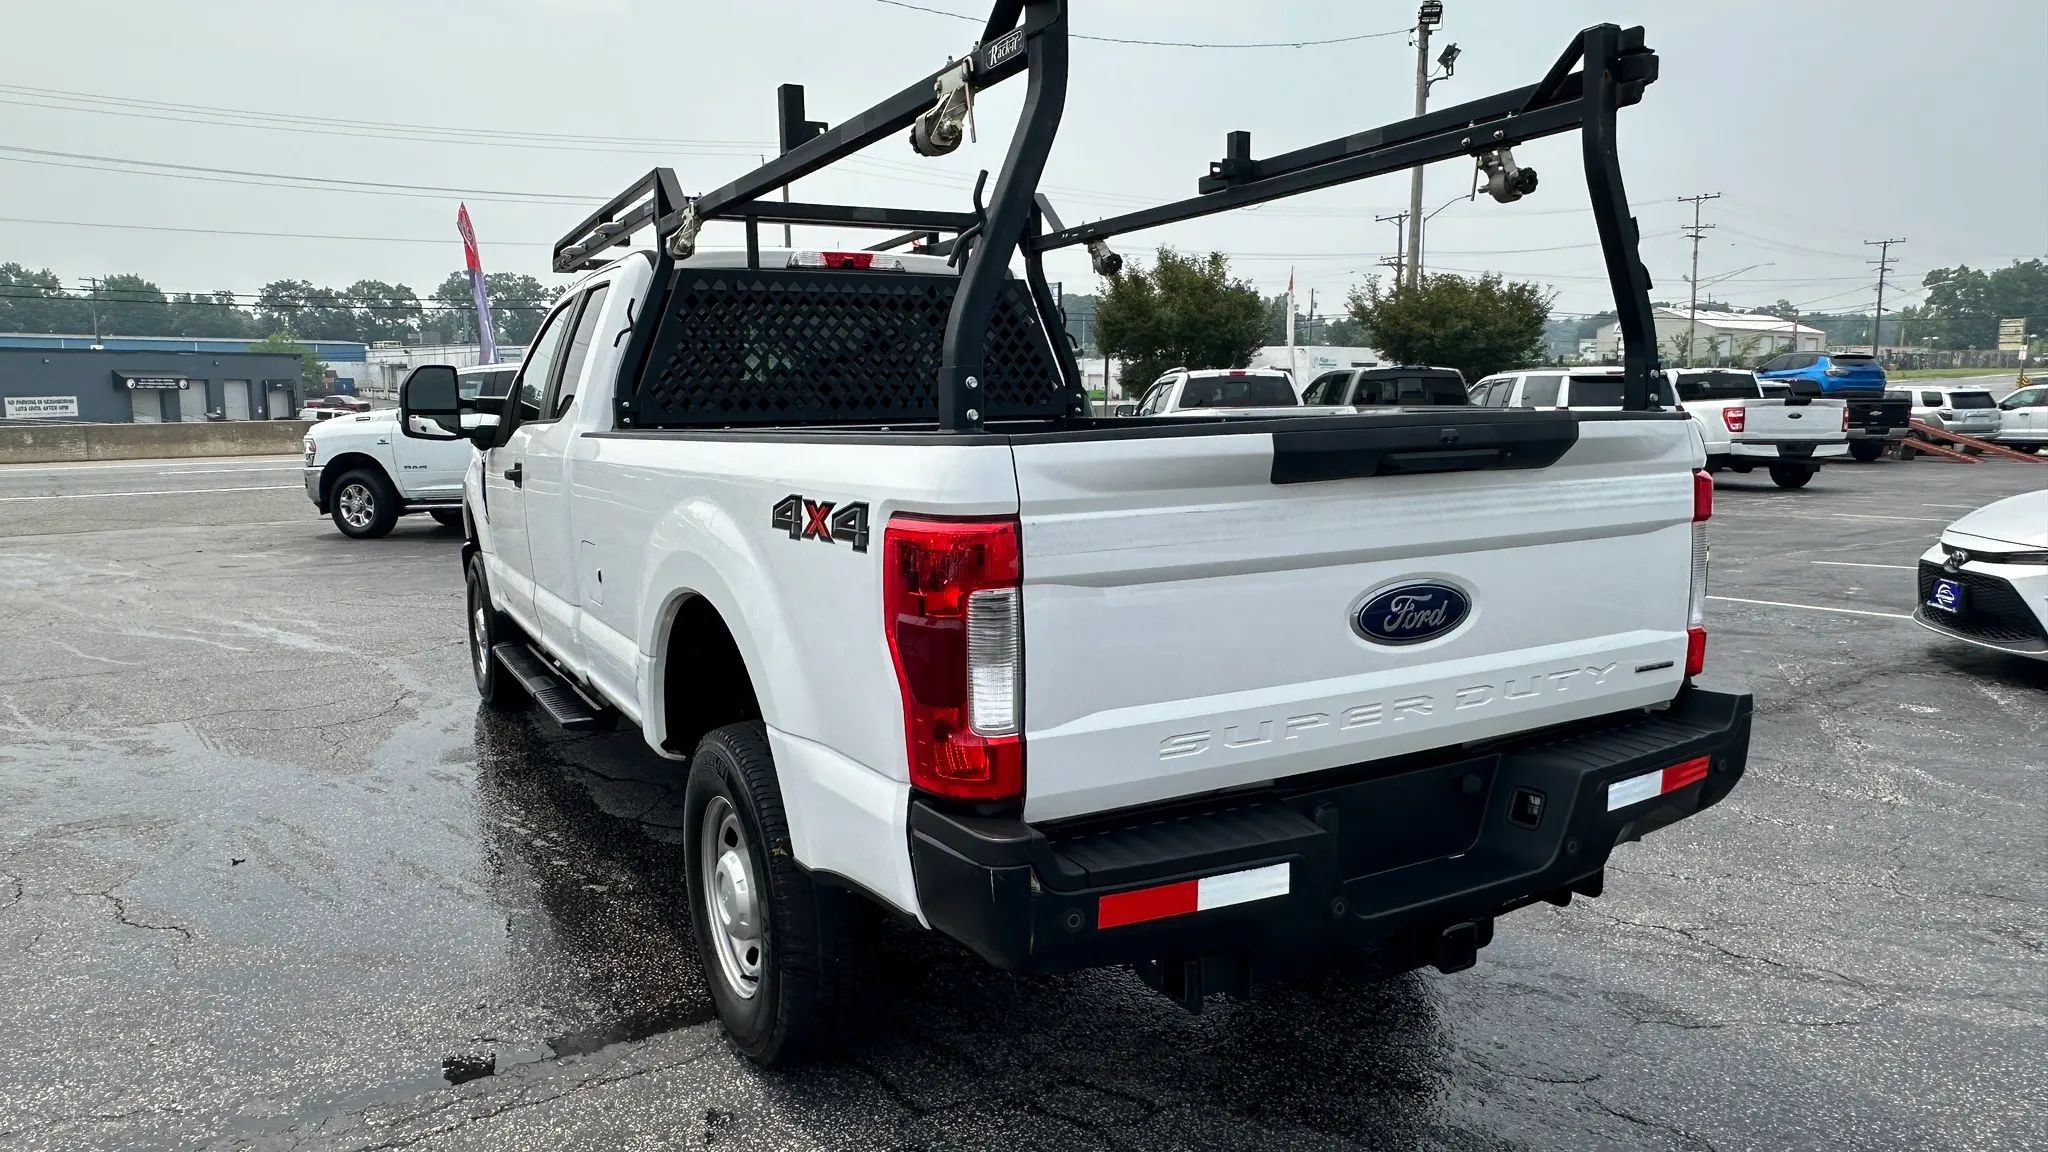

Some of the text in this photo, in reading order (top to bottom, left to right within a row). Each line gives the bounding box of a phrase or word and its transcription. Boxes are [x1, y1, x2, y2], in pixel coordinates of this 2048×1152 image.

[1383, 594, 1448, 632] Ford
[1160, 662, 1617, 760] SUPER DUTY
